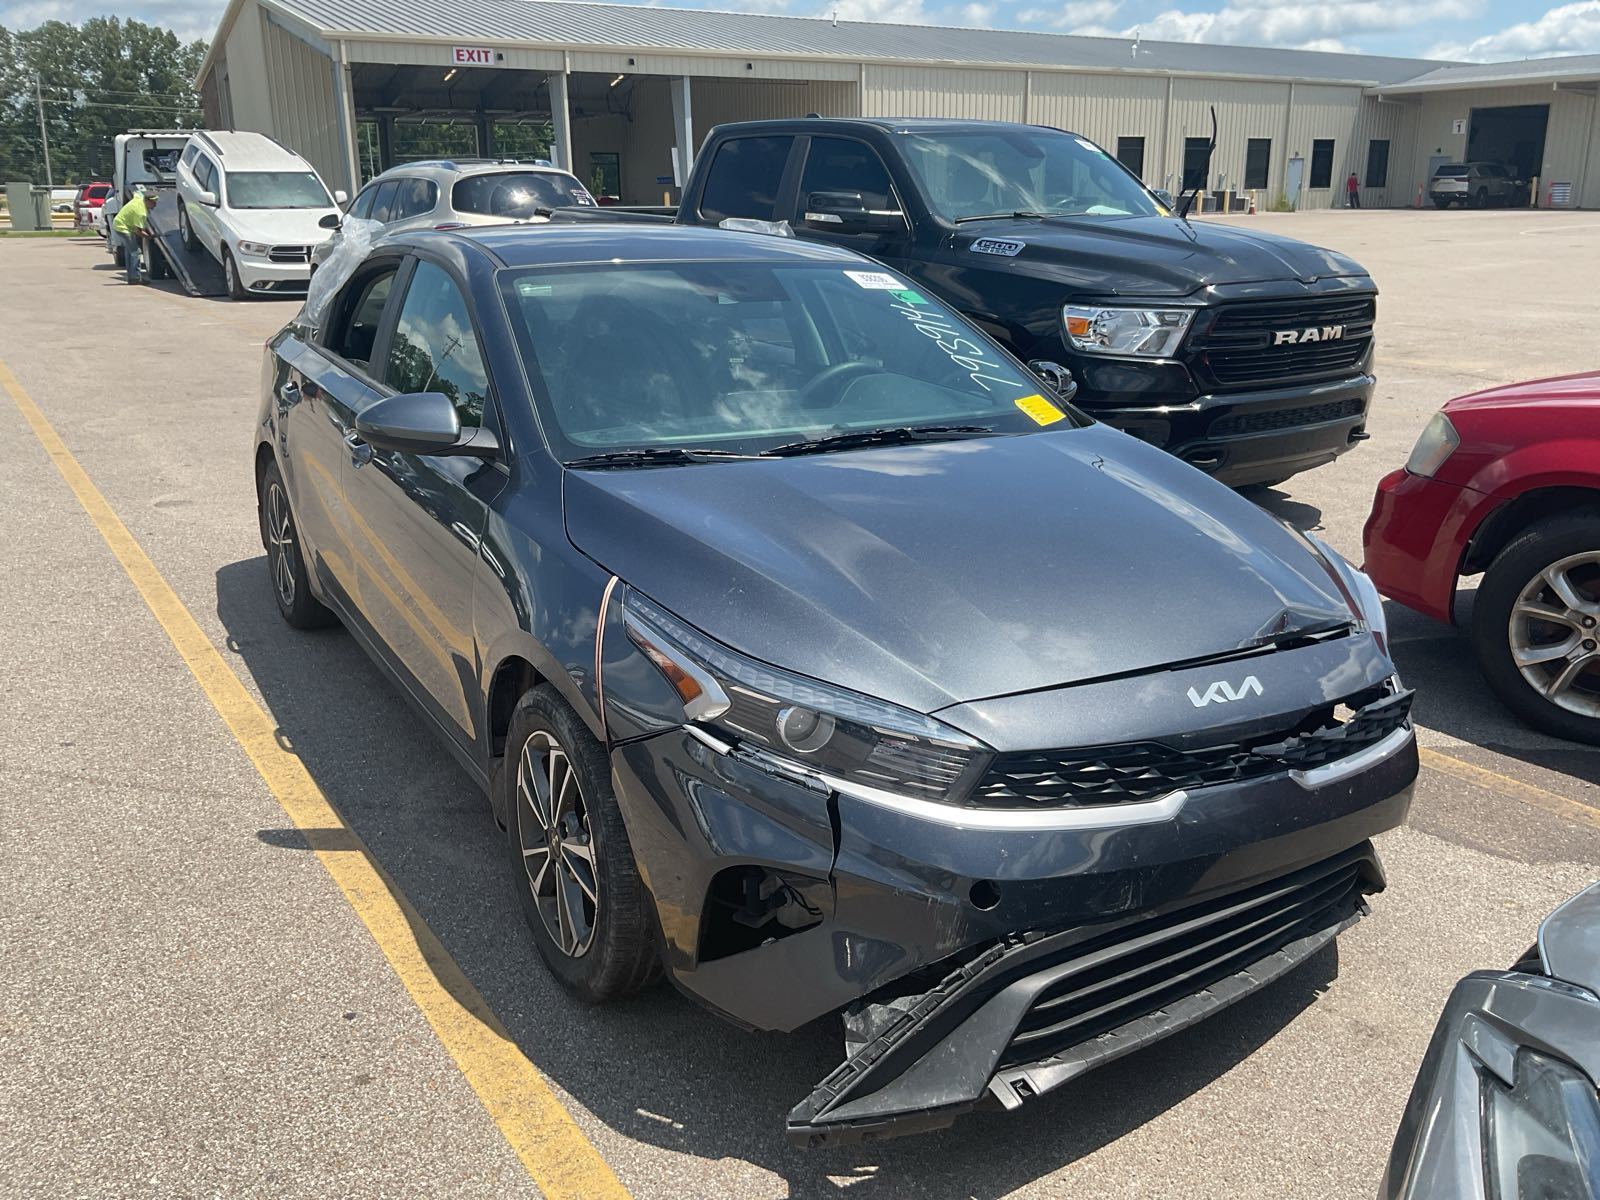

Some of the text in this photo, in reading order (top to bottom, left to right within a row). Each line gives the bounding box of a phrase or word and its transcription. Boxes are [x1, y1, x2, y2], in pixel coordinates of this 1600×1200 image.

[456, 49, 490, 63] EXIT
[979, 241, 1017, 250] 1500
[1273, 324, 1343, 345] RAM
[1186, 675, 1264, 708] KIA
